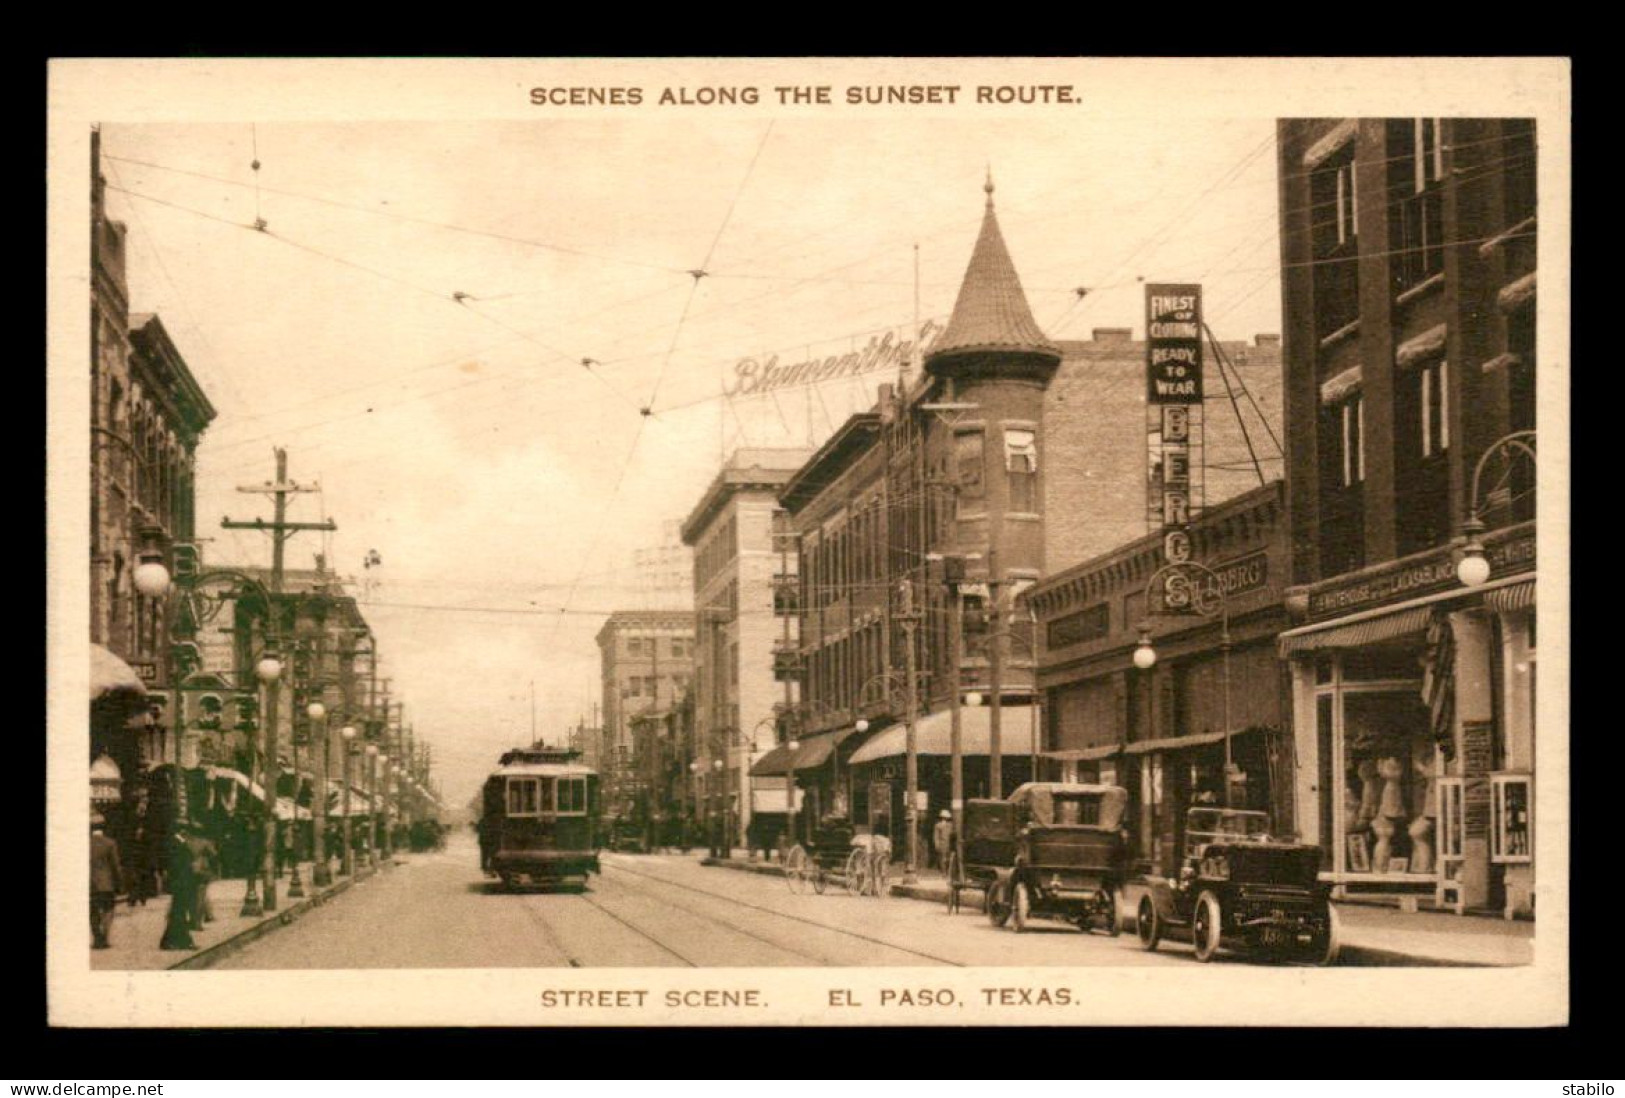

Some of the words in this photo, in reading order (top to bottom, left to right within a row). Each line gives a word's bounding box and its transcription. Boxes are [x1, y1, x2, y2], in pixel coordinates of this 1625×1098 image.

[1152, 295, 1195, 319] FINEST
[1166, 366, 1186, 377] TO
[1155, 379, 1195, 395] WEAR
